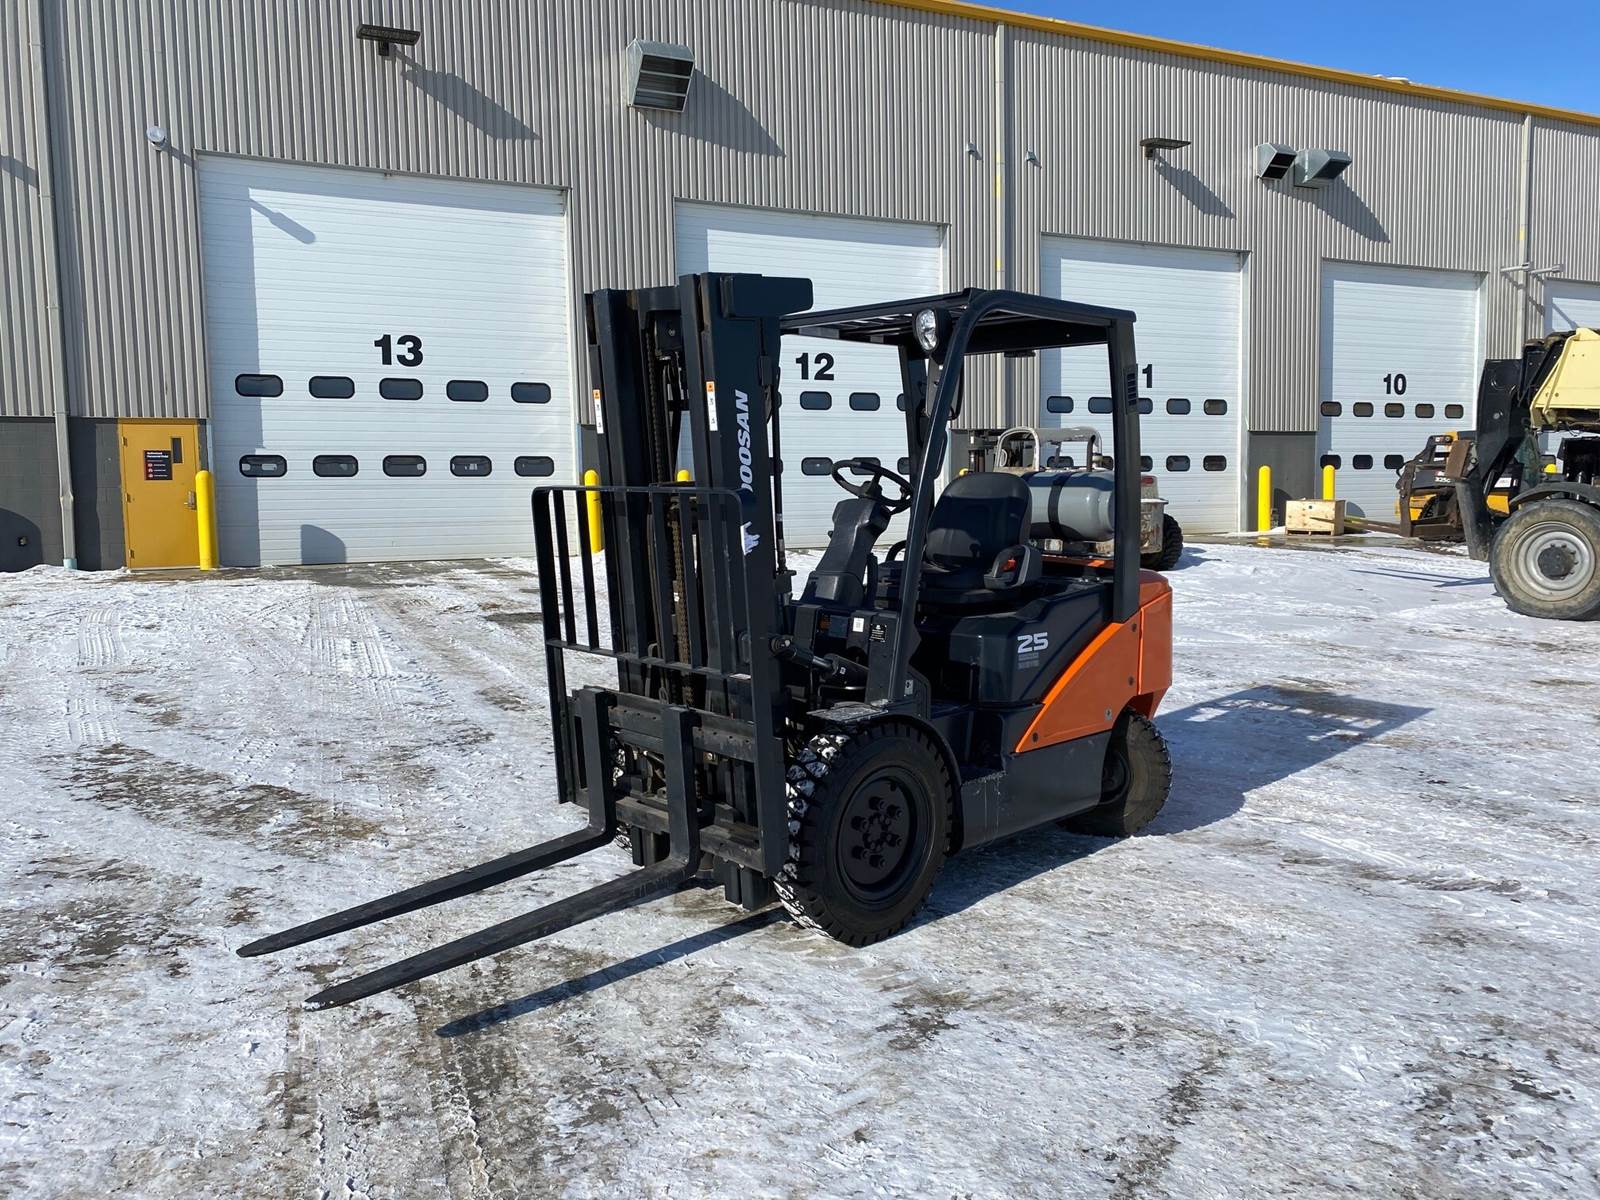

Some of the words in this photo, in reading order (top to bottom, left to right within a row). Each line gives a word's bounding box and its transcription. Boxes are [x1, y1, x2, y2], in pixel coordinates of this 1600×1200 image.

[374, 334, 423, 368] 13
[795, 352, 835, 381] 12
[1136, 363, 1153, 389] 1
[1383, 373, 1407, 396] 10
[1017, 632, 1049, 654] 25
